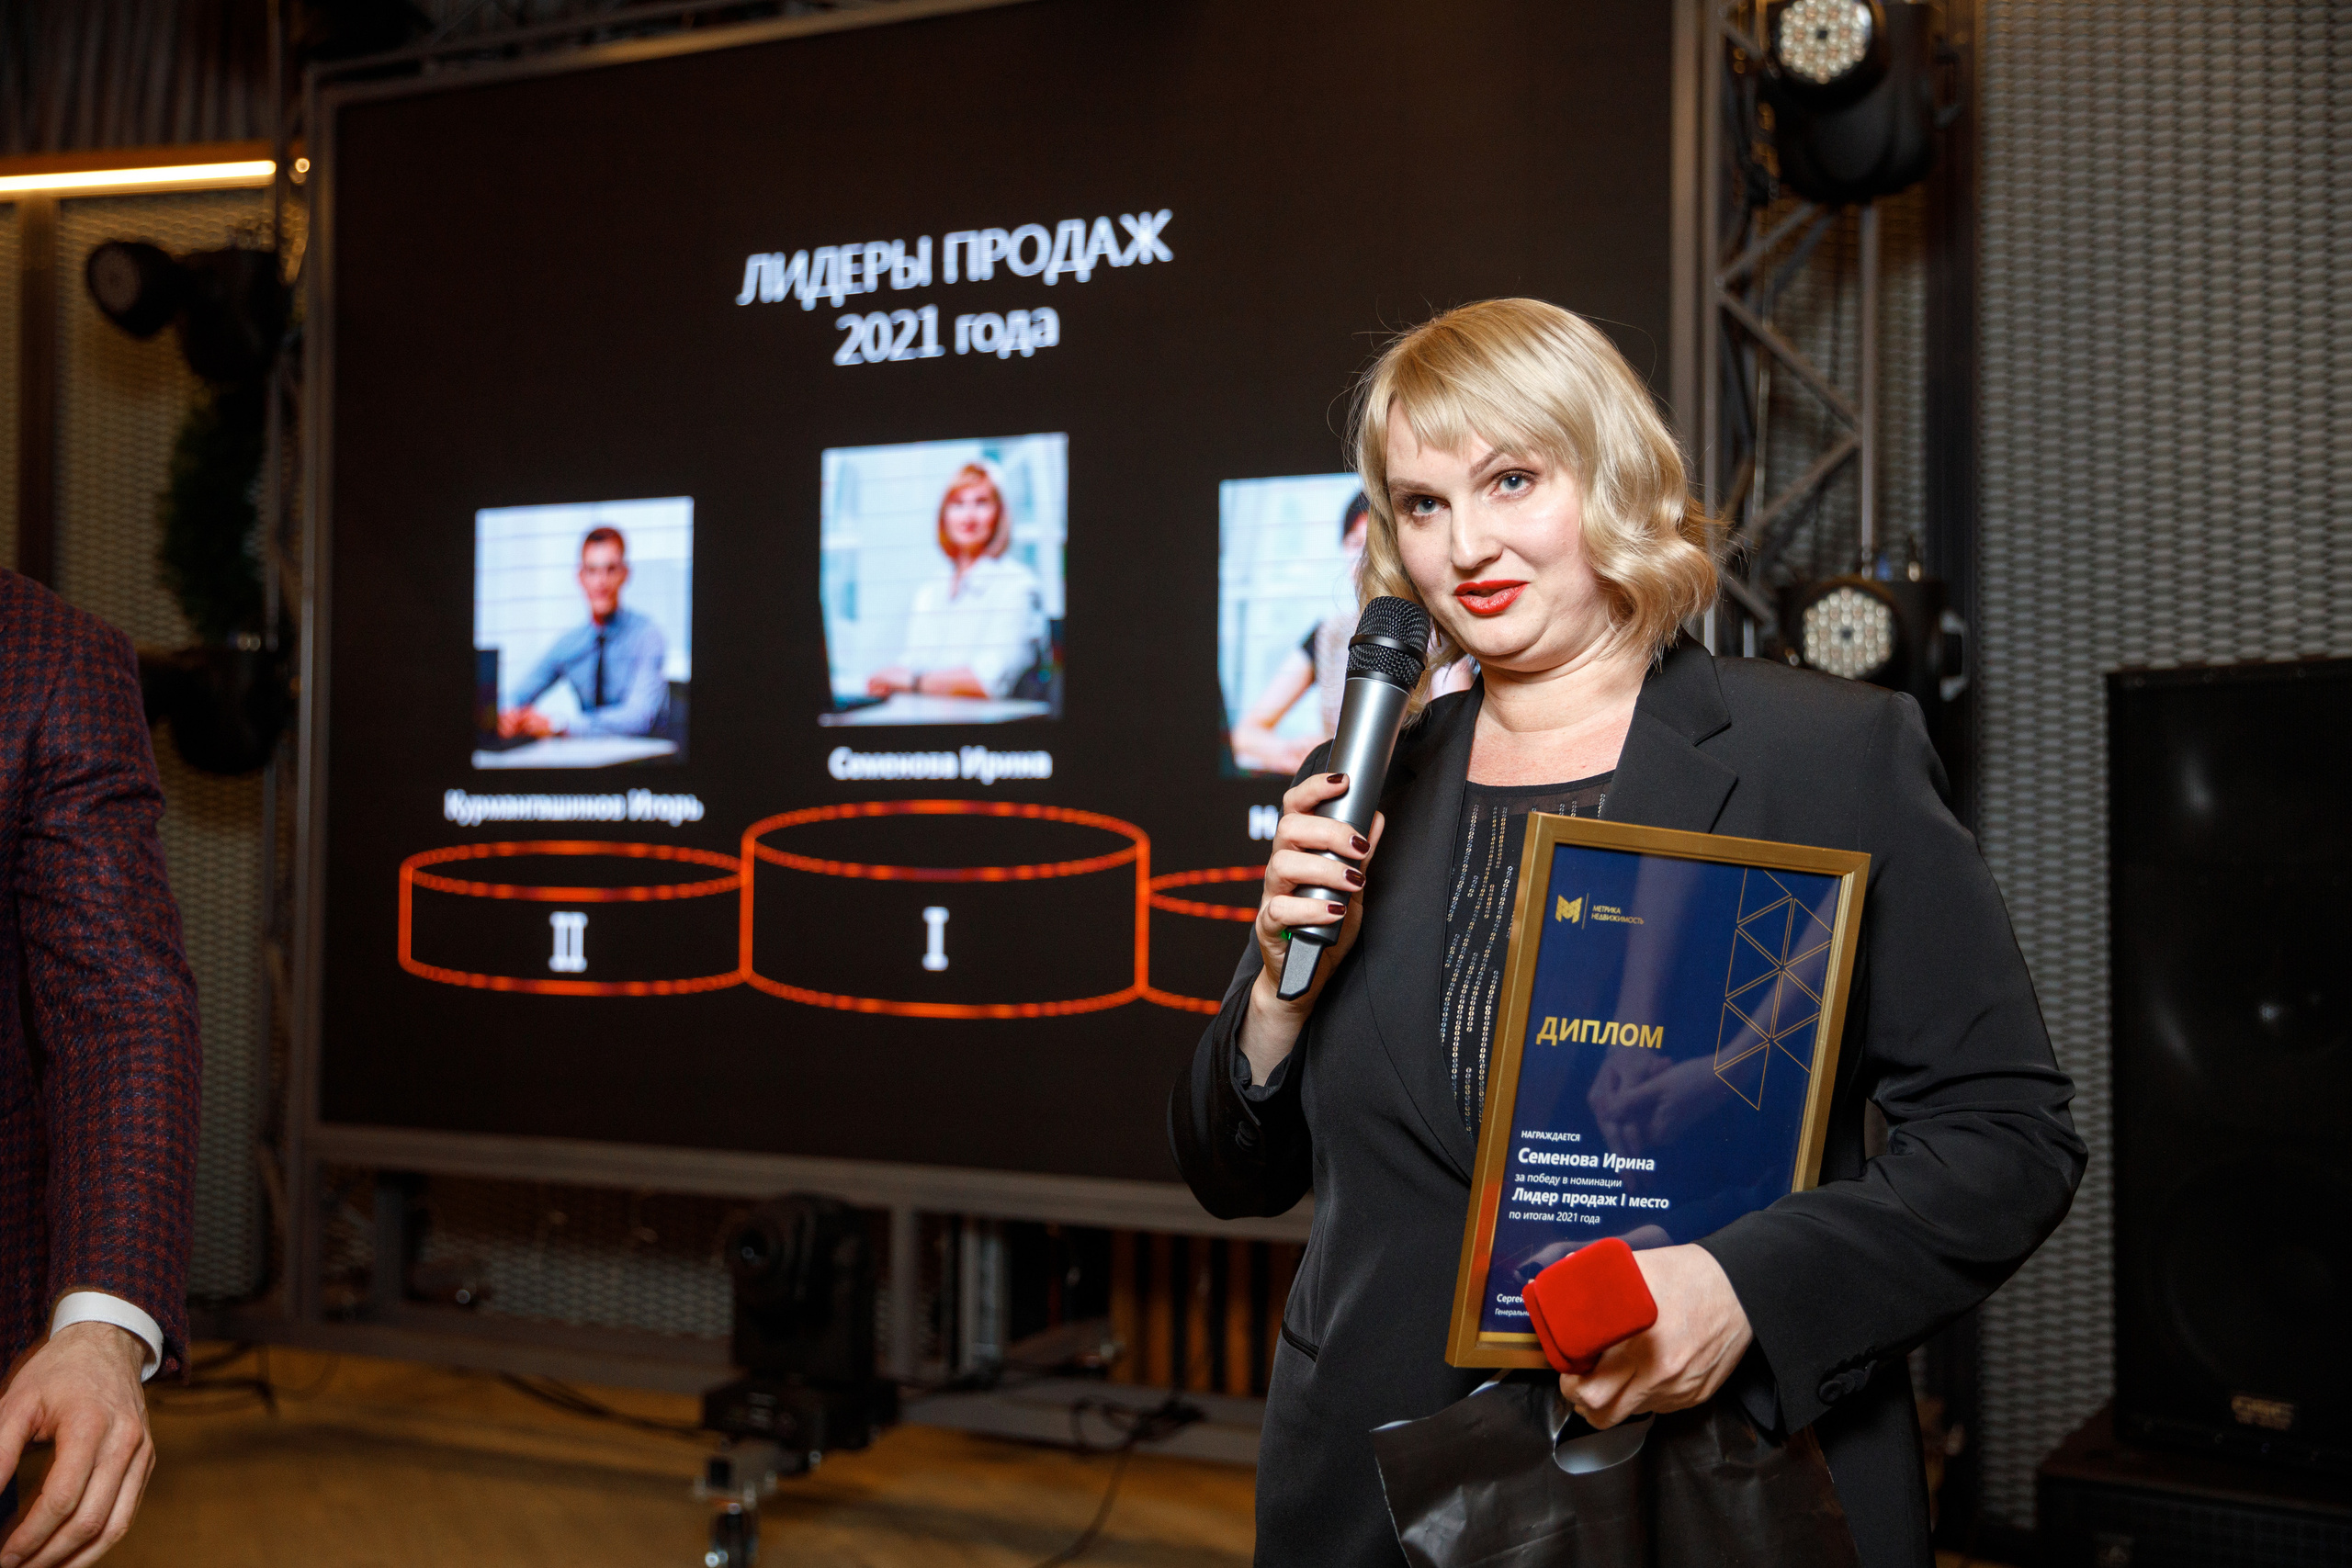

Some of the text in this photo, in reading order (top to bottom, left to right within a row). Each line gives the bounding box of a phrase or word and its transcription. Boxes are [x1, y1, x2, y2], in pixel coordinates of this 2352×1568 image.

[736, 209, 1173, 310] ЛИДЕРЫ ПРОДАЖ
[833, 304, 1060, 366] 2021 года
[1591, 913, 1645, 925] НЕДВИЖИМОСТЬ
[1592, 905, 1621, 915] МЕТРИКА
[1535, 1016, 1664, 1049] ДИПЛОМ
[1521, 1130, 1580, 1142] НАГРАЖДАЕТСЯ
[1518, 1147, 1656, 1172] Семенова Ирина
[1515, 1173, 1623, 1189] за победу в номинации
[1511, 1187, 1559, 1205] Лидер
[1562, 1192, 1617, 1208] продаж
[1629, 1197, 1669, 1209] место
[1509, 1211, 1600, 1224] по итогам 2021 года
